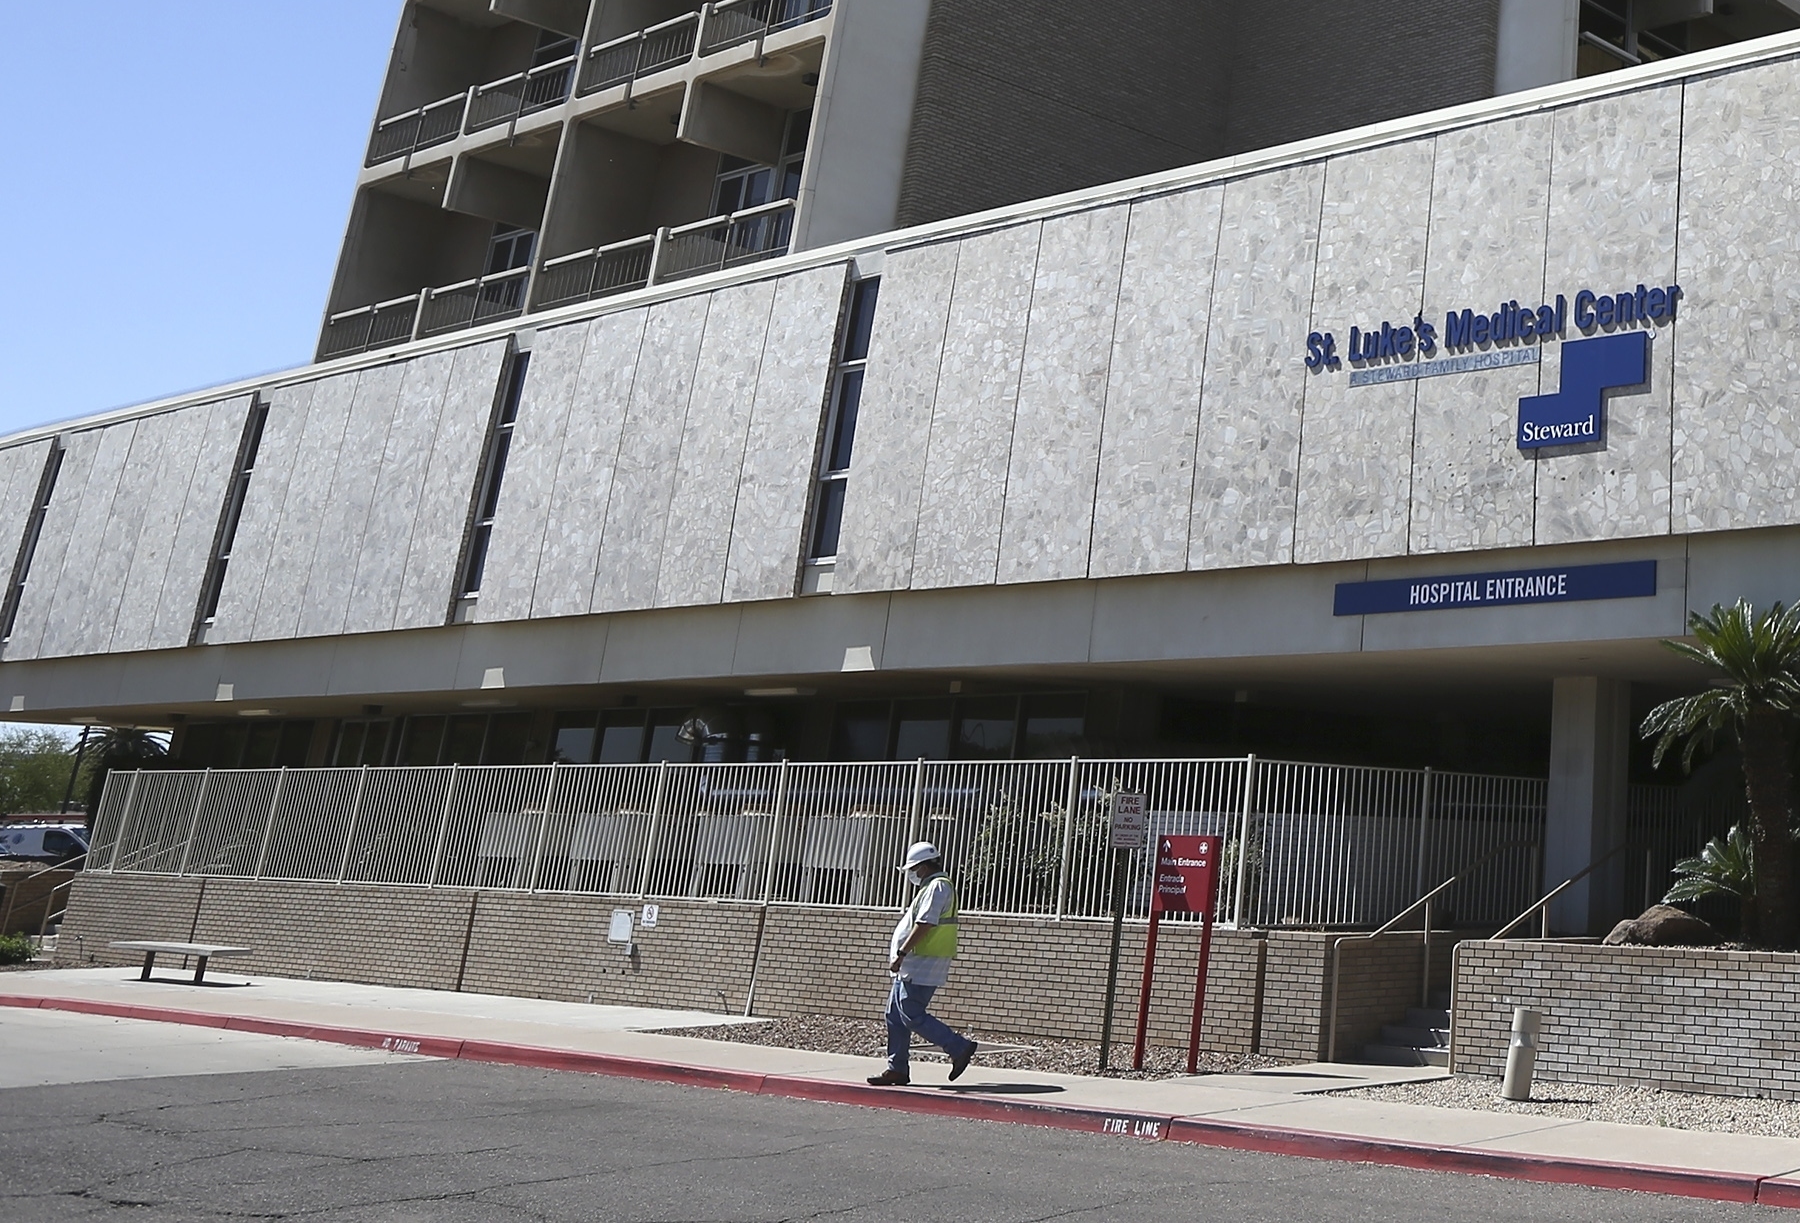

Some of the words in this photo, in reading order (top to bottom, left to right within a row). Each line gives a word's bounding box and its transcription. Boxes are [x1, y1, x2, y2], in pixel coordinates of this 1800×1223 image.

[1304, 331, 1339, 367] St.
[1348, 316, 1435, 361] Luke's
[1444, 294, 1564, 348] Medical
[1574, 284, 1681, 328] Center
[1362, 364, 1419, 384] STEWARD
[1424, 357, 1470, 375] FAMILY
[1473, 347, 1540, 370] HOSPITAL
[1522, 414, 1594, 442] Steward
[1409, 580, 1481, 606] HOSPITAL
[1485, 573, 1568, 600] ENTRANCE
[1121, 796, 1140, 805] FIRE
[1118, 806, 1141, 814] LANE
[1114, 823, 1141, 831] PARKING
[1160, 857, 1177, 866] Main
[1177, 857, 1207, 868] Entrance
[1159, 873, 1185, 883] Entrada
[1158, 884, 1187, 895] Principal
[1103, 1118, 1130, 1133] FIRE
